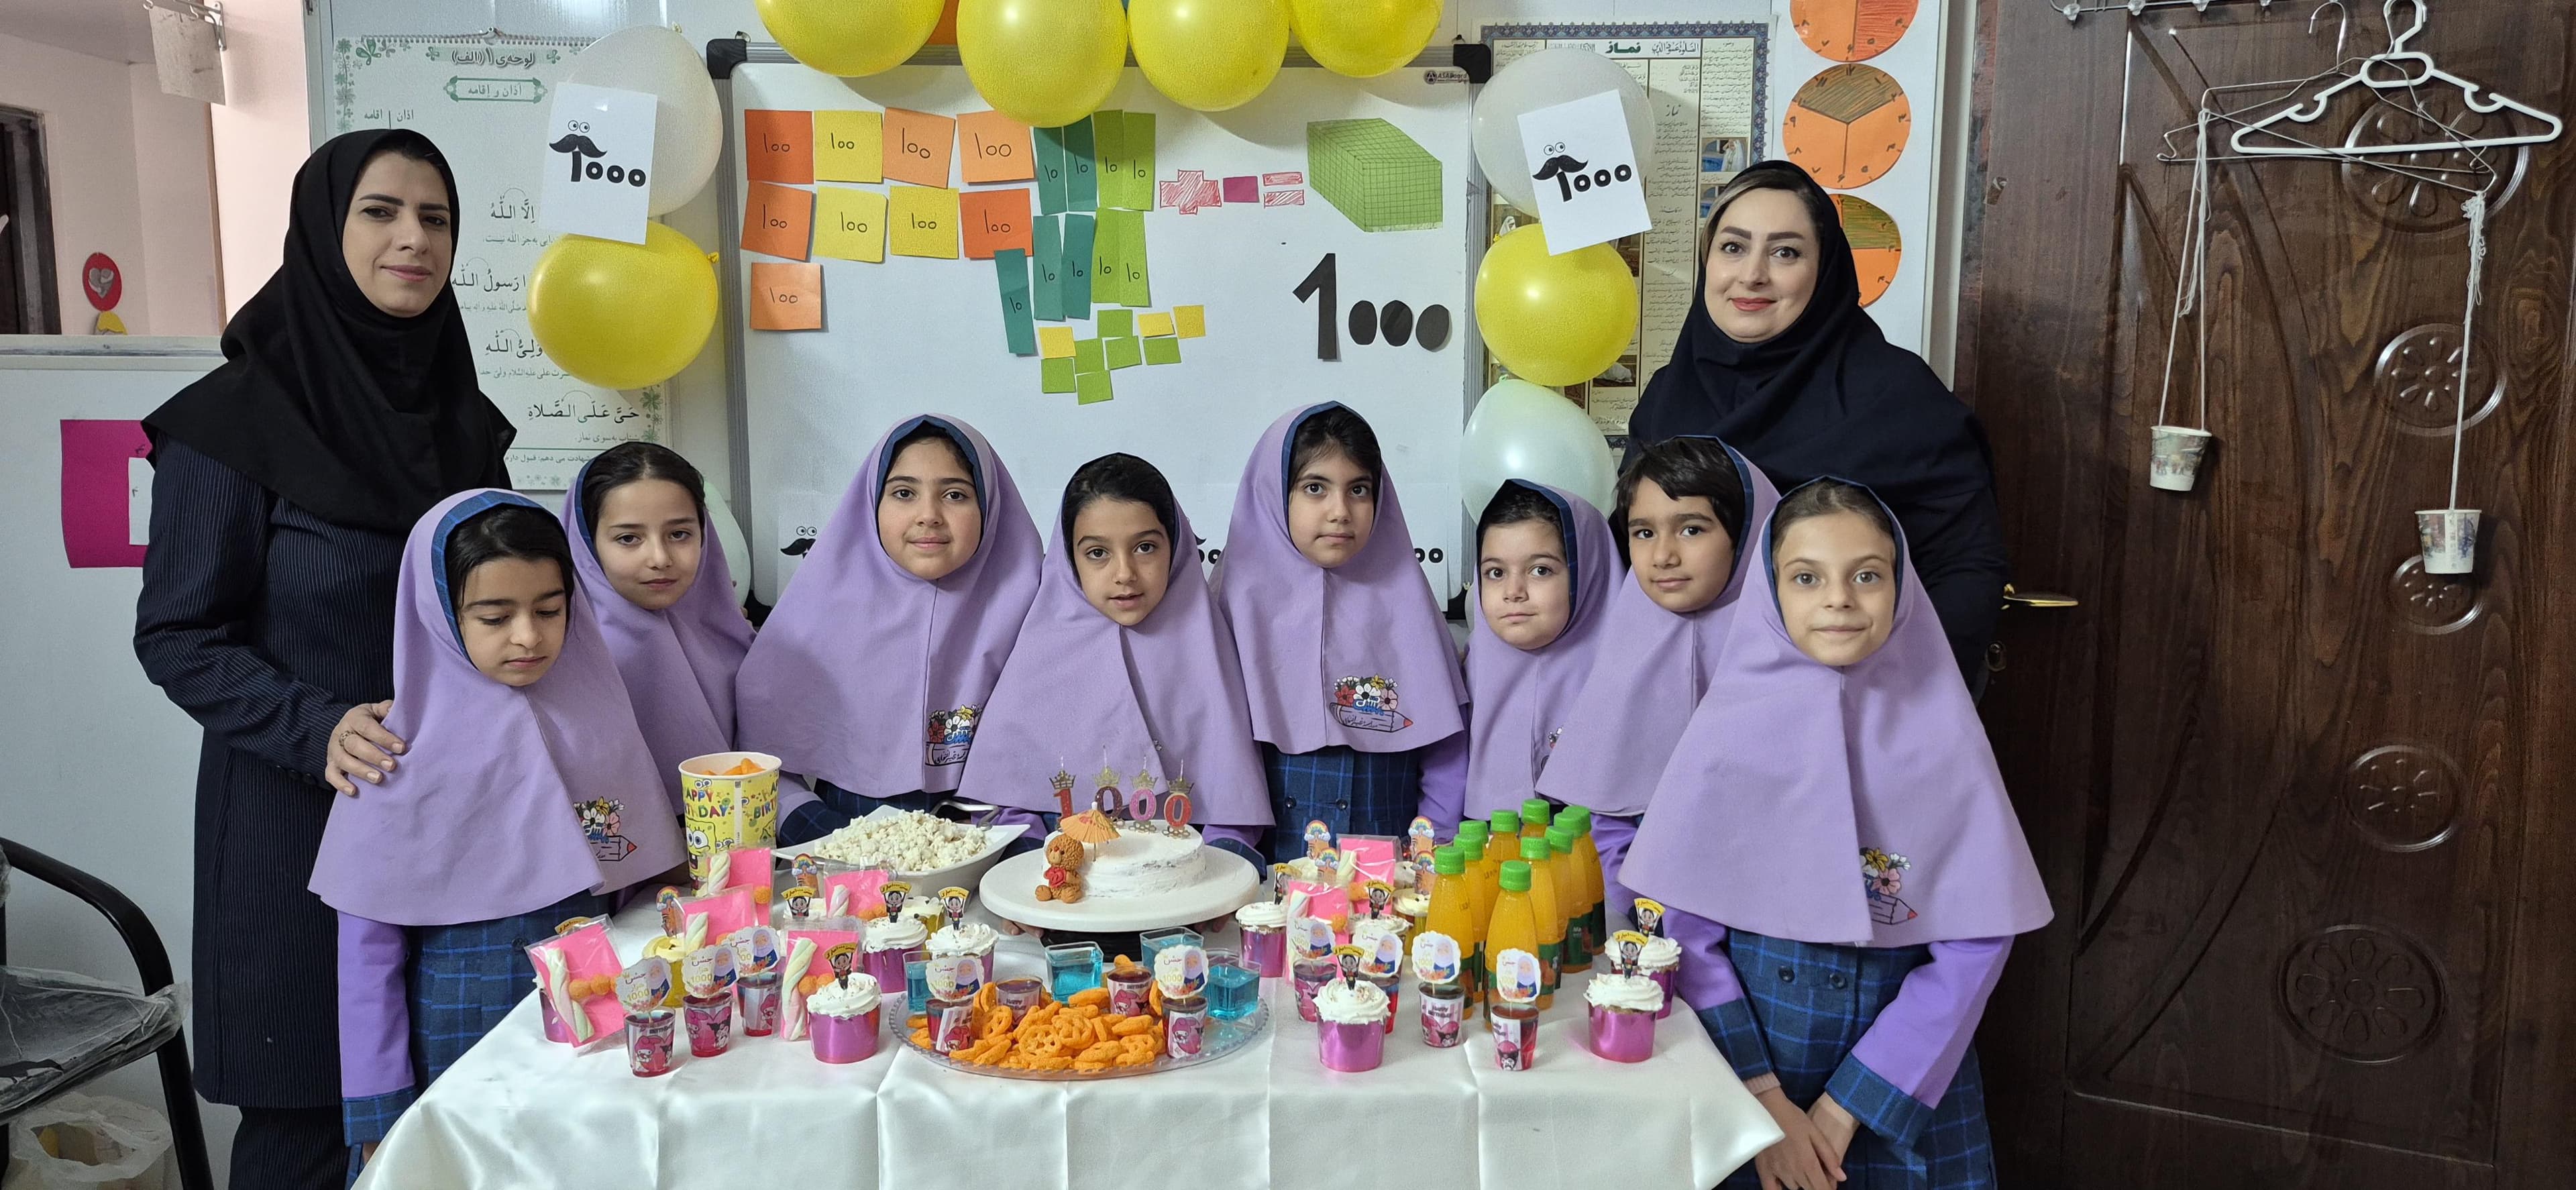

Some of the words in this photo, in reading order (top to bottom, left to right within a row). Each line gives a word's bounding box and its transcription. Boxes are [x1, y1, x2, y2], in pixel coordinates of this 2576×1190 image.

[1605, 41, 1641, 54] نماز
[686, 788, 713, 802] APPY
[692, 955, 714, 967] جشن
[1164, 955, 1183, 965] جشن
[625, 972, 647, 985] جشن
[627, 989, 650, 1002] 1000
